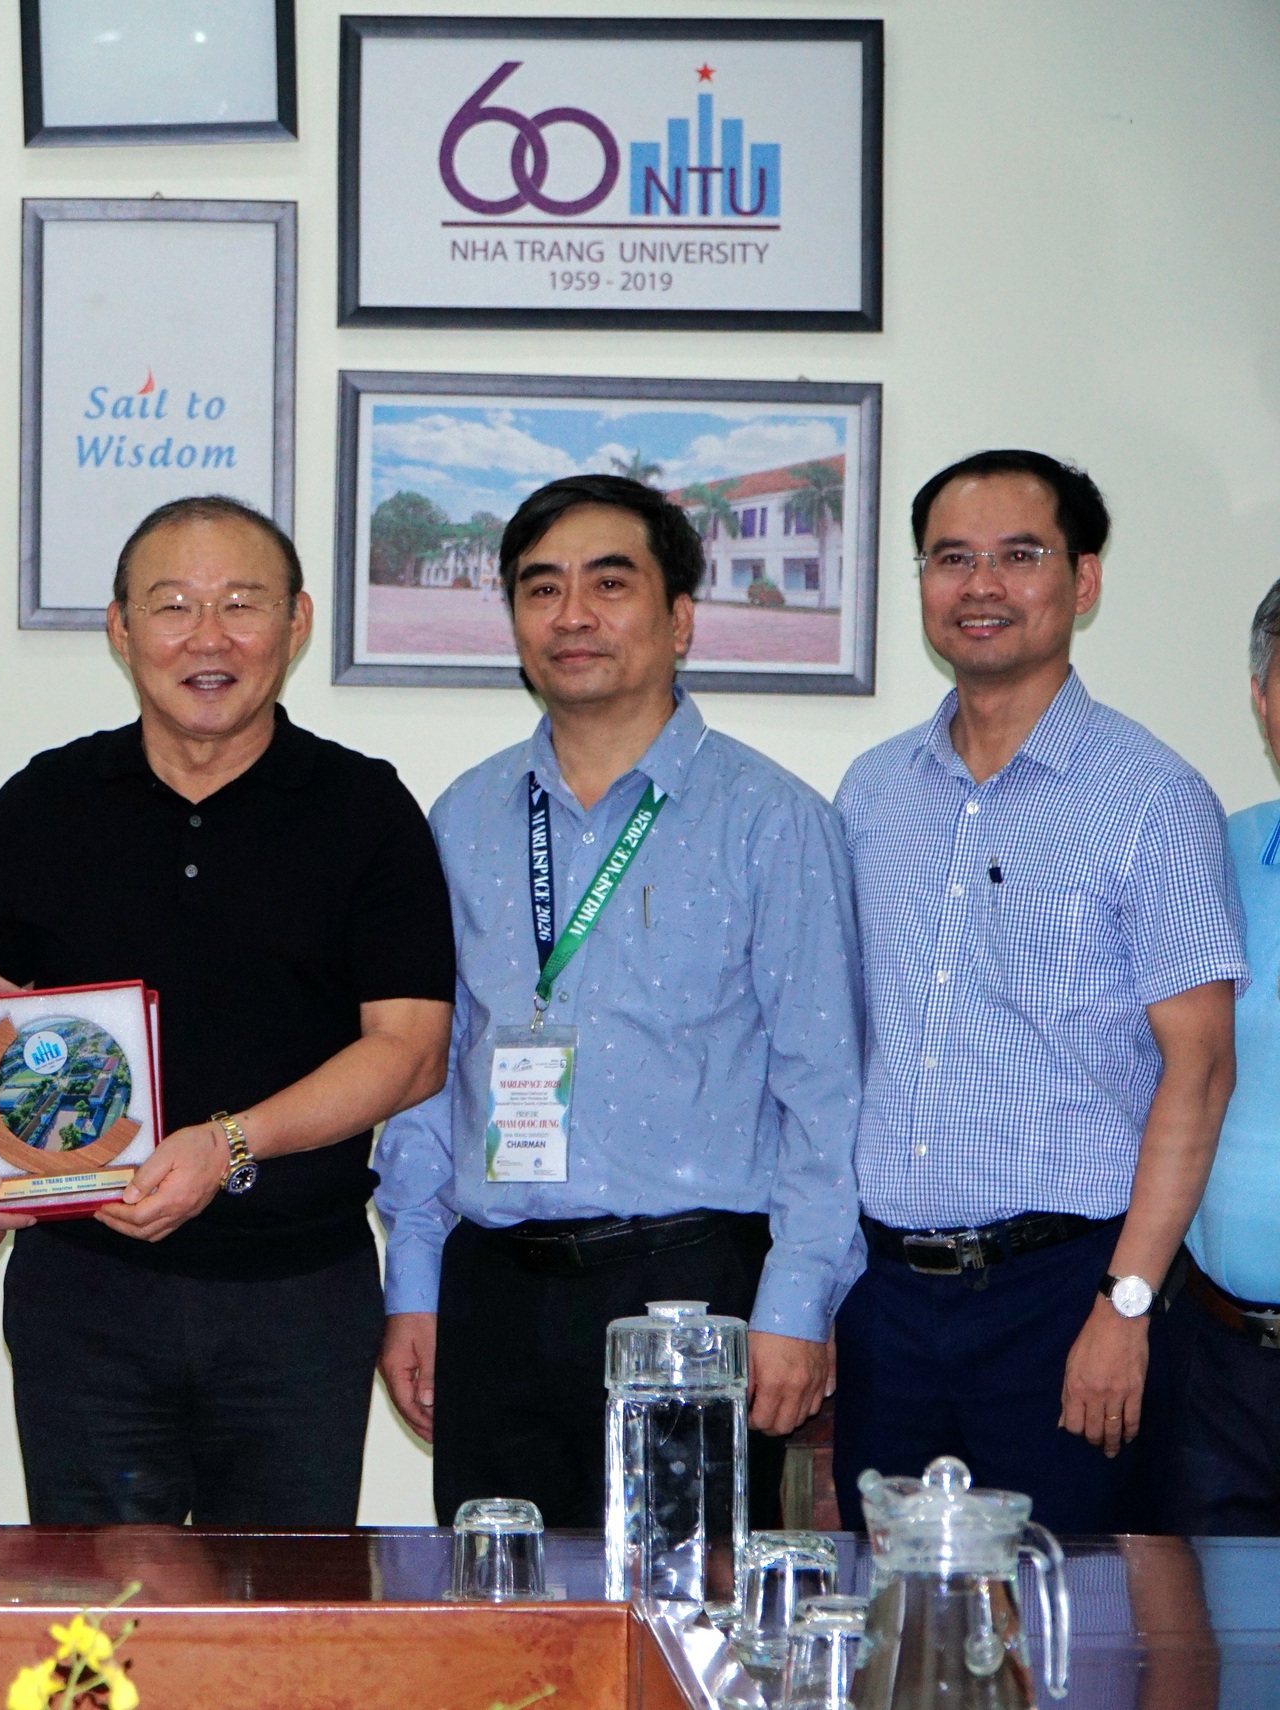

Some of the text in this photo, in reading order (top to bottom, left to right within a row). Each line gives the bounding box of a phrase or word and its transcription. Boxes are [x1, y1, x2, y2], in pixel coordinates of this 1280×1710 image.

[439, 61, 767, 216] 60 NTU
[450, 240, 771, 265] NHA TRANG UNIVERSITY
[549, 271, 601, 292] 1959
[619, 271, 674, 293] 2019
[83, 376, 227, 421] Sail to
[75, 433, 238, 469] Wisdom
[531, 809, 553, 942] MARLISPACE 2026
[569, 808, 653, 940] MARLISPACE 2026
[34, 1047, 60, 1066] NTU
[506, 1140, 547, 1149] CHAIRMAN
[32, 1174, 98, 1187] NHA TRANG UNIVERSITY
